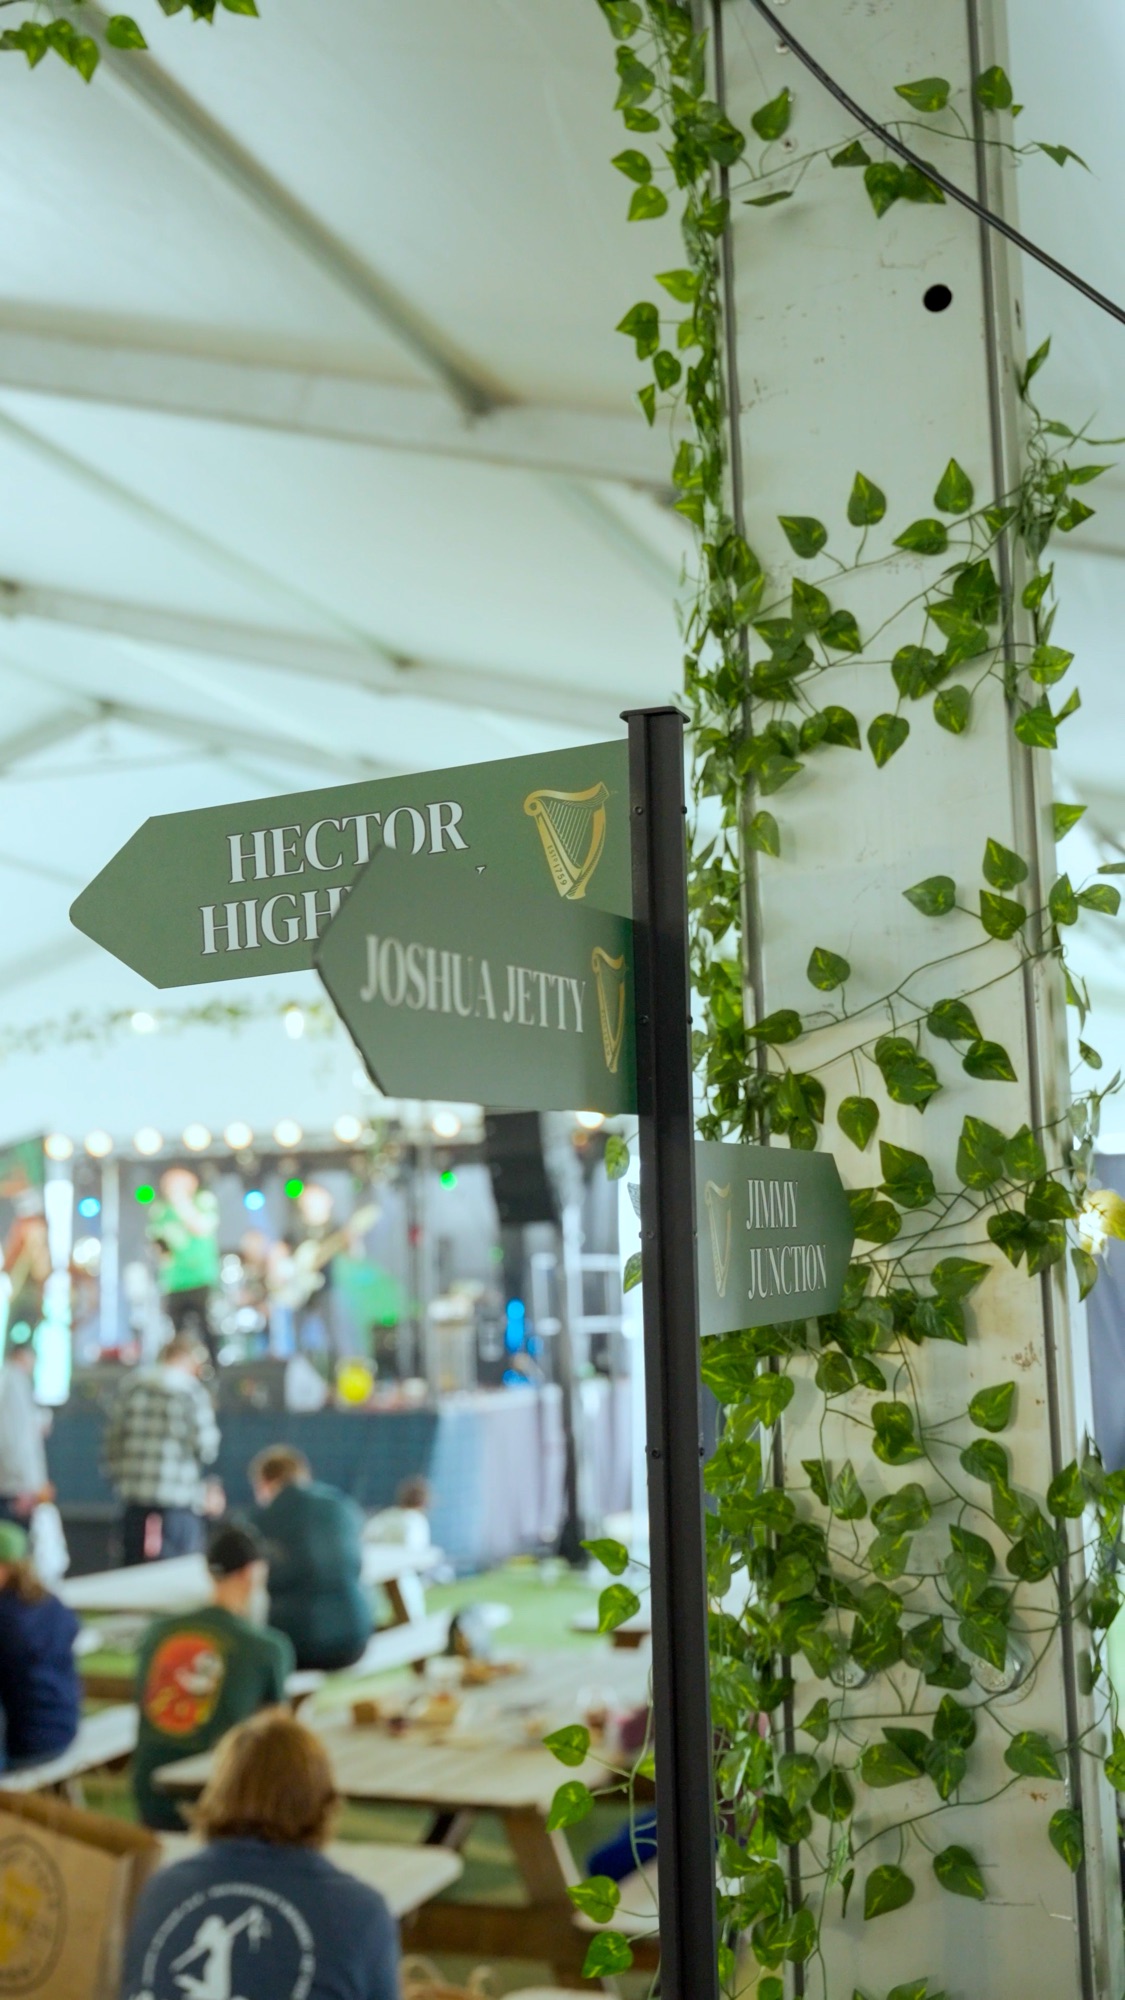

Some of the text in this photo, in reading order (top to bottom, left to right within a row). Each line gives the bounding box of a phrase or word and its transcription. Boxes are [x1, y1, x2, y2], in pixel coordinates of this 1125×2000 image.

[227, 801, 468, 883] HECTOR
[553, 864, 568, 885] 1759
[360, 934, 497, 1020] JOSHUA
[502, 965, 586, 1033] JETTY
[746, 1178, 798, 1231] JIMMY
[748, 1244, 827, 1300] JUNCTION
